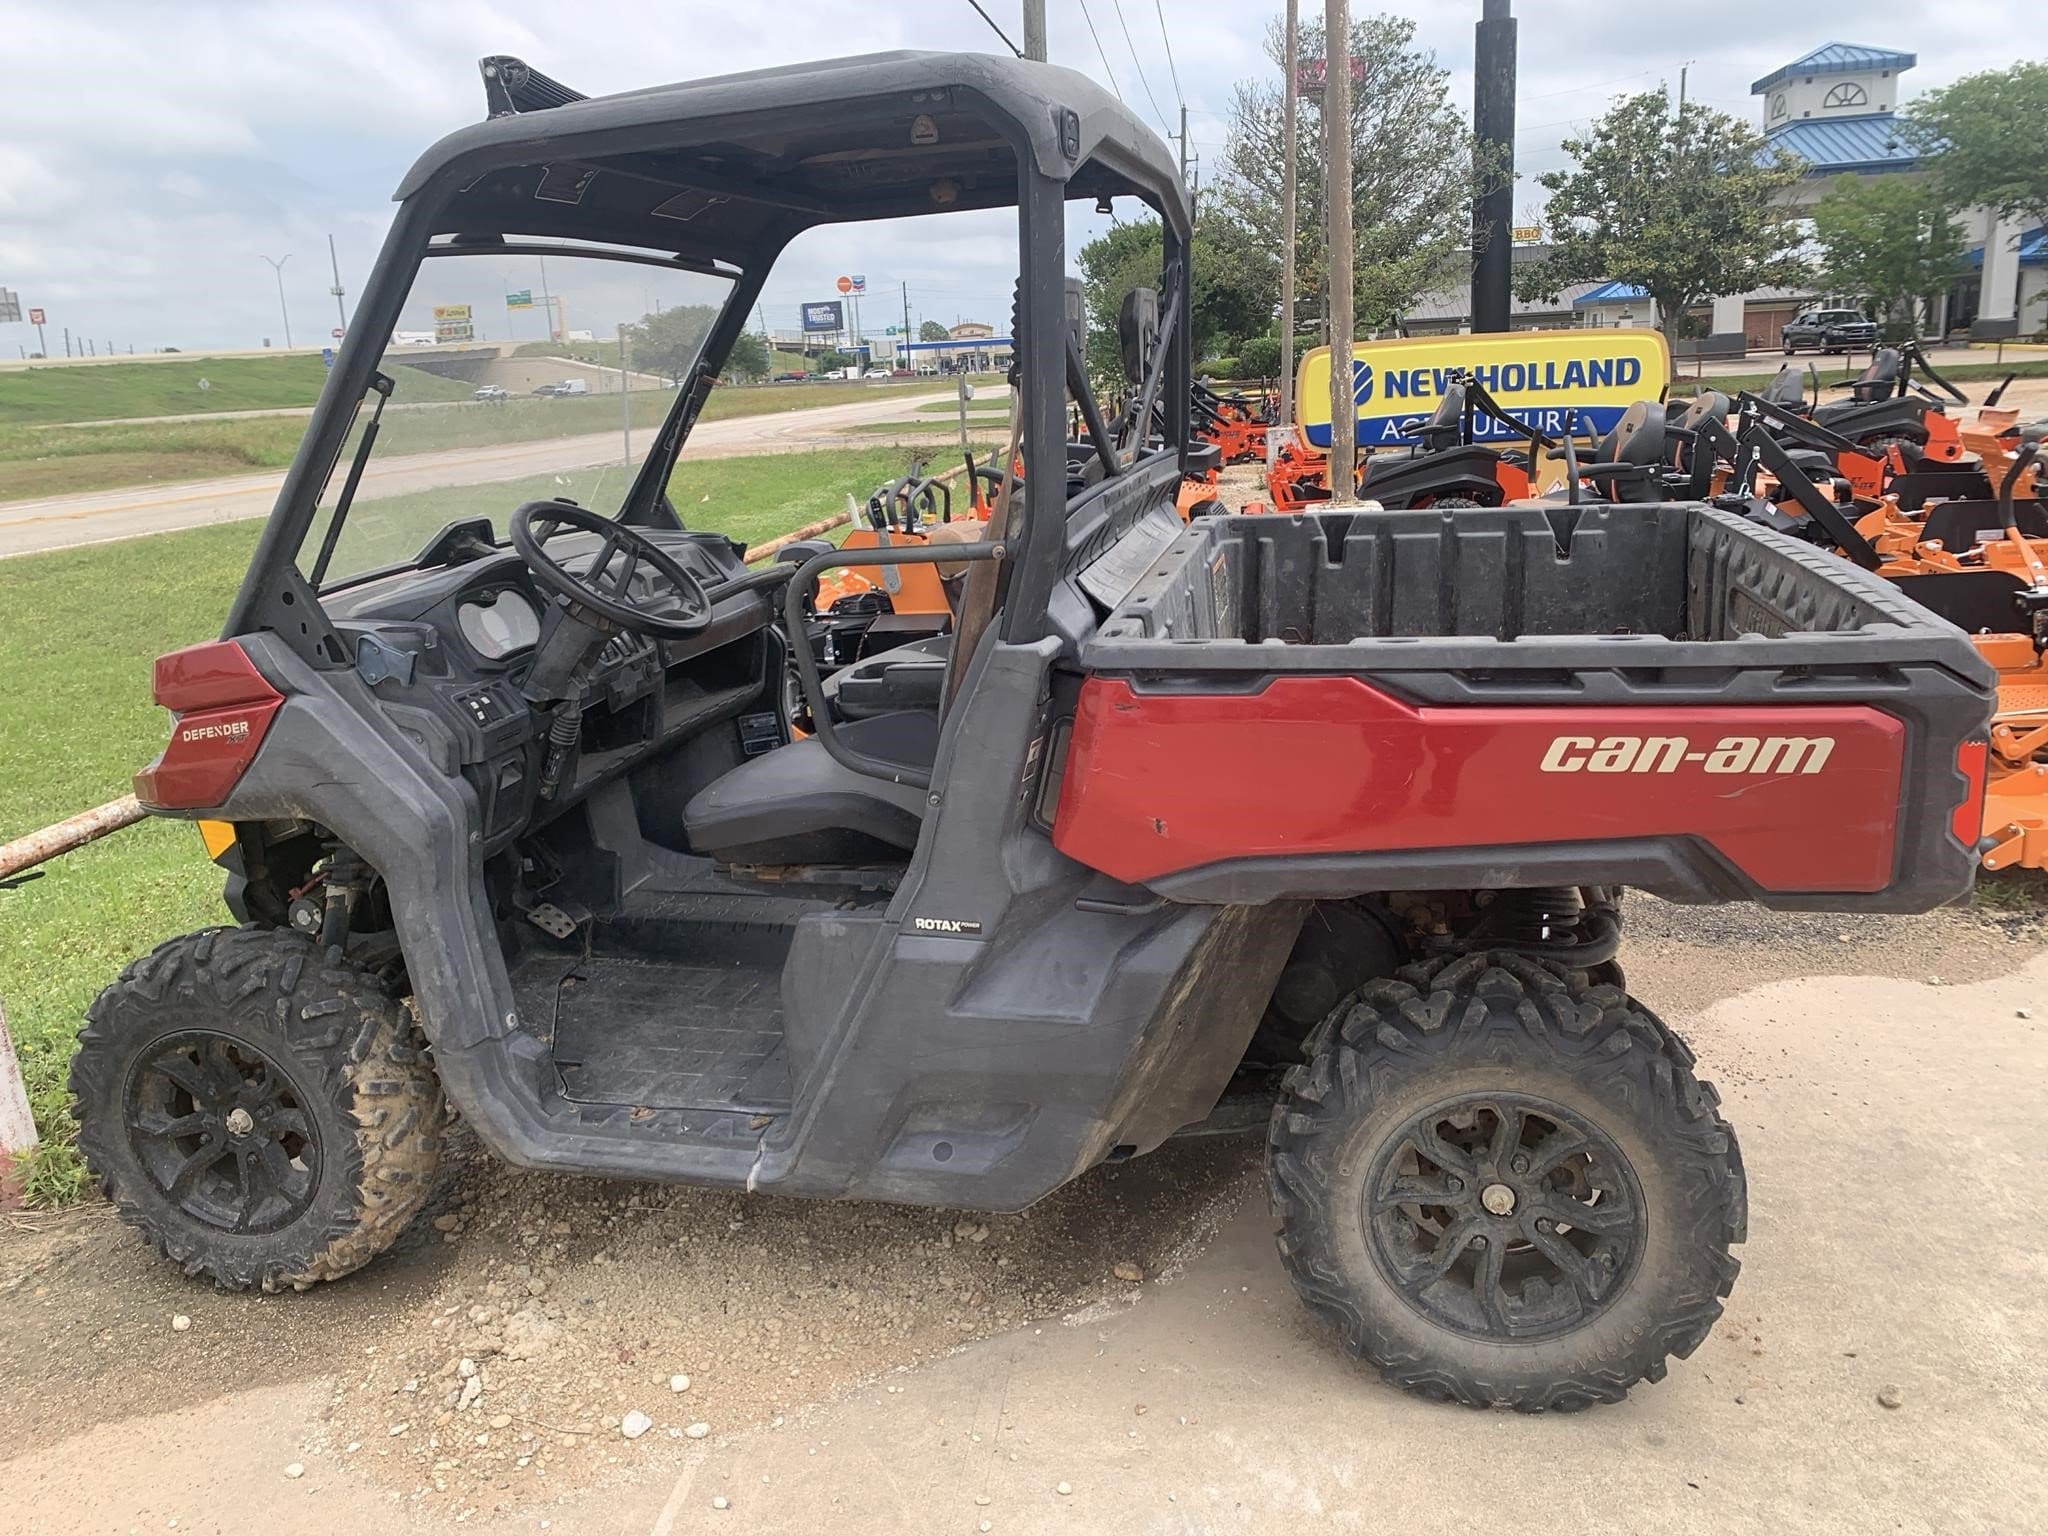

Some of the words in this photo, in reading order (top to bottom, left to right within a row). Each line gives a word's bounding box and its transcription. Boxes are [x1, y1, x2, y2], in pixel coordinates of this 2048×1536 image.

[808, 313, 836, 322] TRUSTED
[1384, 367, 1466, 399] NEW
[1475, 357, 1642, 393] HOLLAND
[182, 721, 249, 742] DEFENDER
[1540, 735, 1836, 774] can-am
[914, 917, 962, 933] ROTAX
